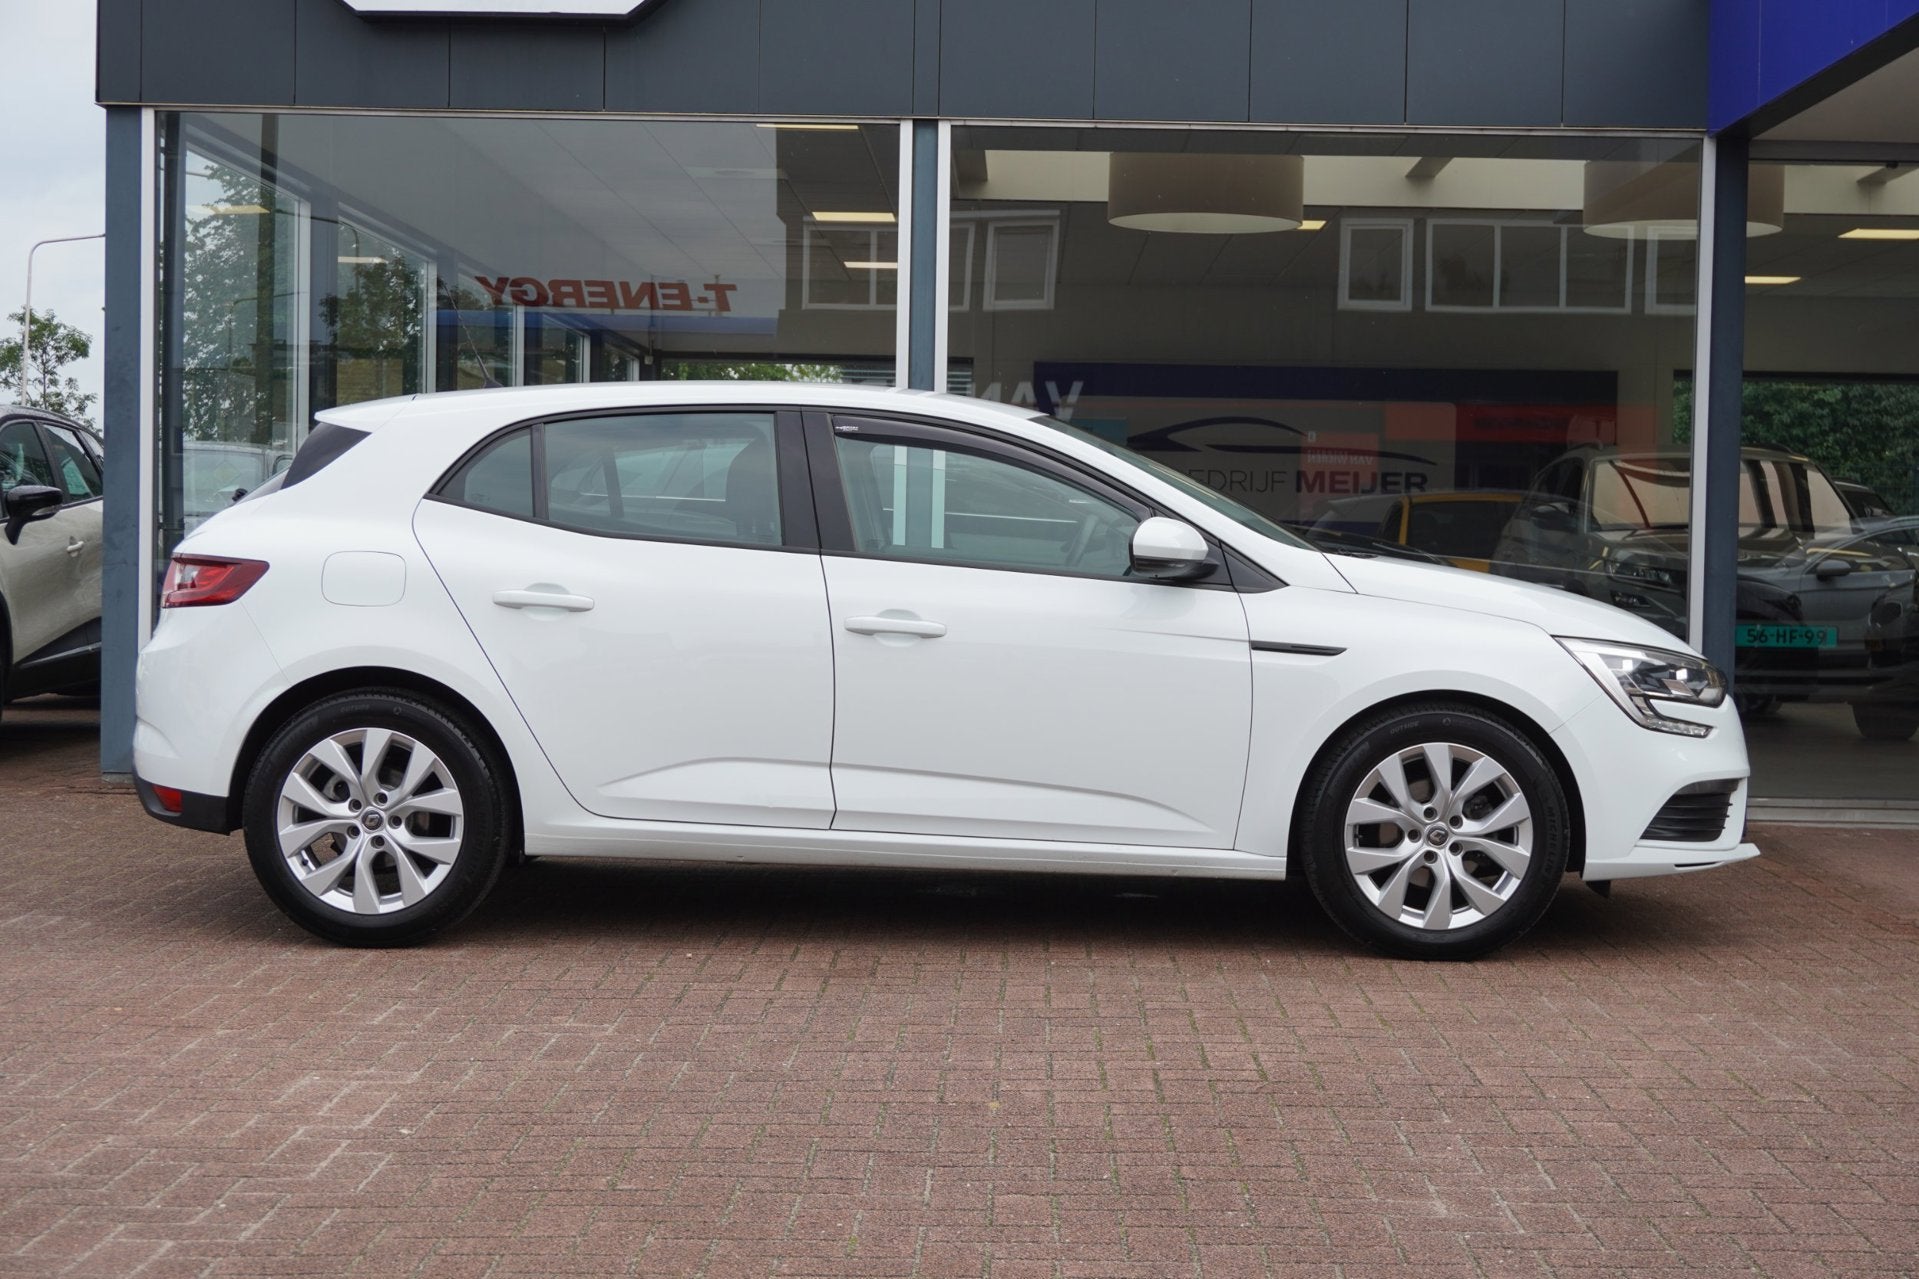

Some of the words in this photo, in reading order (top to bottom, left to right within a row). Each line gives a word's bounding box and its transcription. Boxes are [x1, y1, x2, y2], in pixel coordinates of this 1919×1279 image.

[1297, 470, 1429, 493] MEIJER
[1747, 628, 1828, 645] 56-HF-99
[1390, 720, 1420, 735] OUTSIDE
[1542, 806, 1557, 877] MICHELIN
